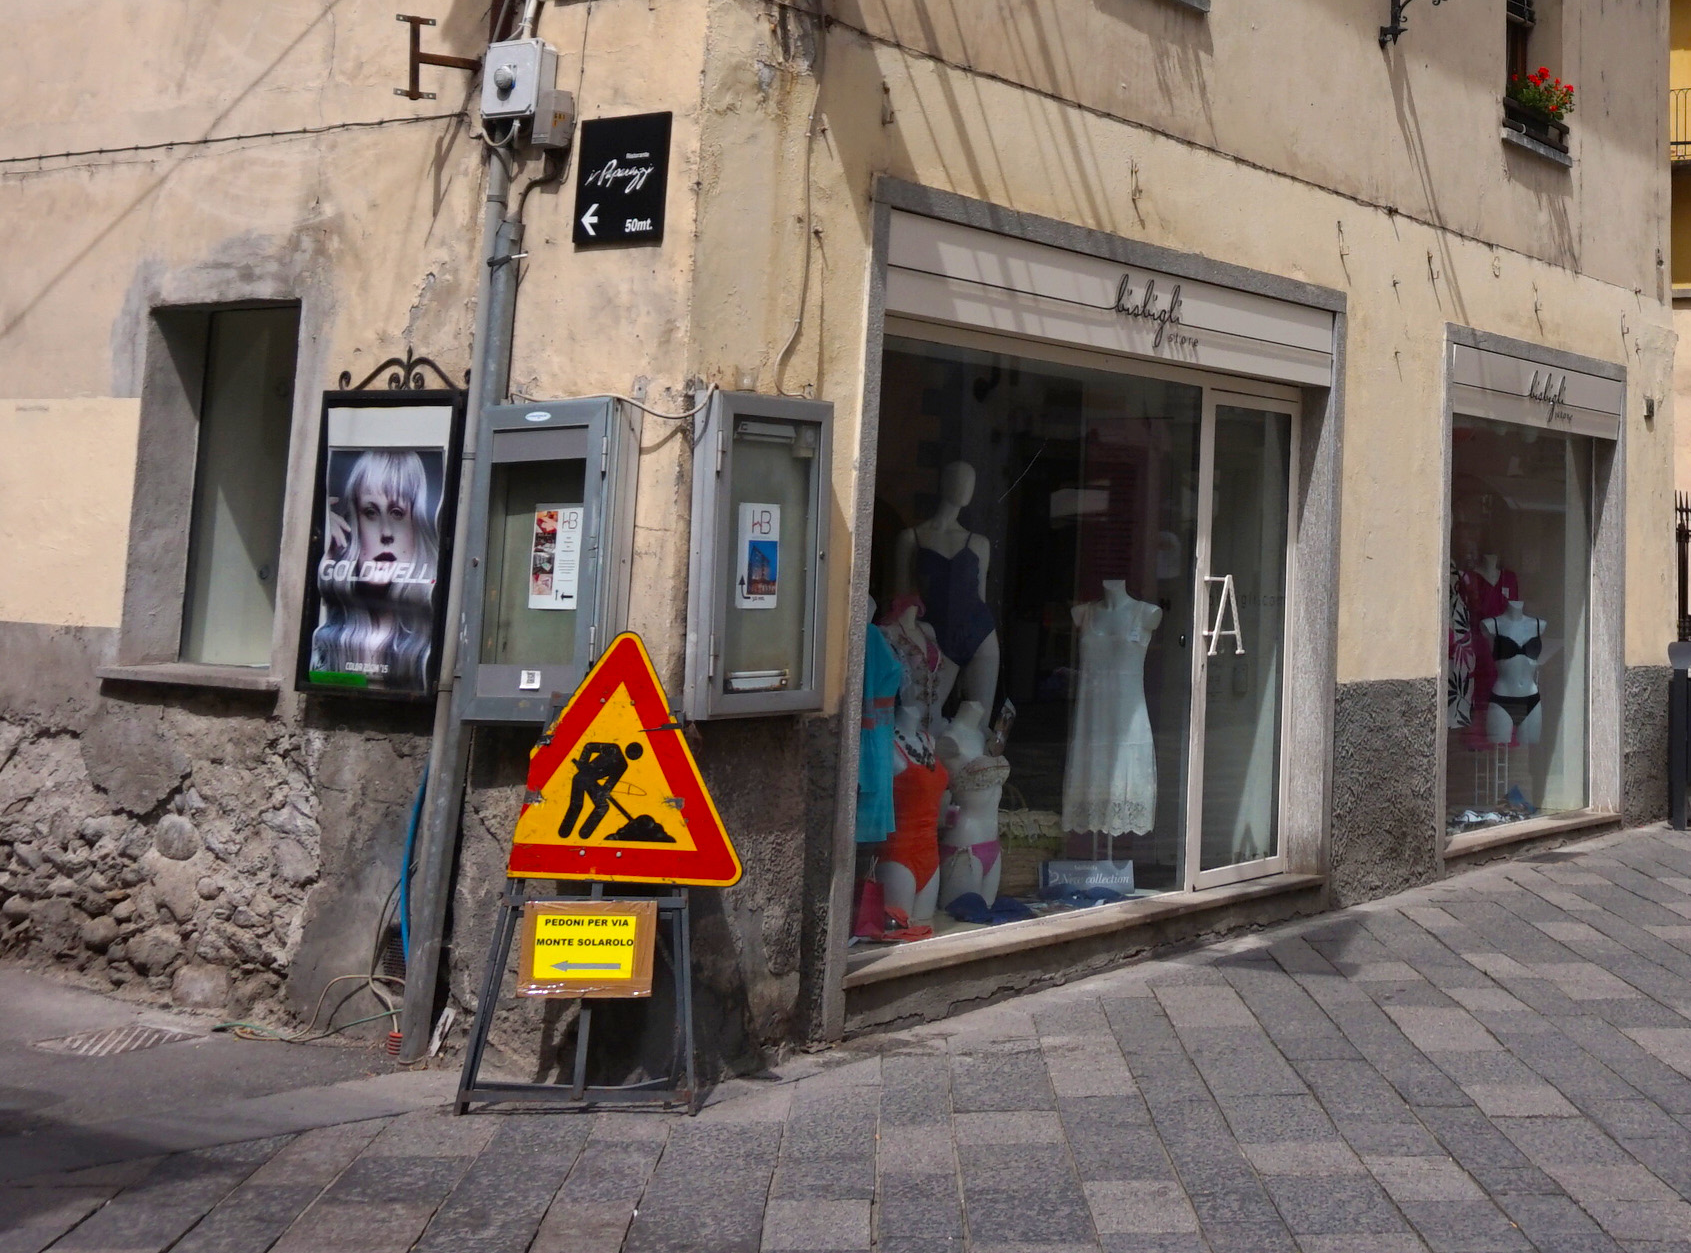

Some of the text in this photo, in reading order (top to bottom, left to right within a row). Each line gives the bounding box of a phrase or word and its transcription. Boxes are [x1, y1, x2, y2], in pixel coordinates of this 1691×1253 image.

[624, 217, 653, 233] 50mt.
[1114, 273, 1183, 349] bisbigli
[1167, 333, 1199, 347] store
[1085, 872, 1130, 885] collection
[545, 918, 630, 927] PEDONI PER VIA
[536, 938, 634, 947] MONTE SOLAROLO
